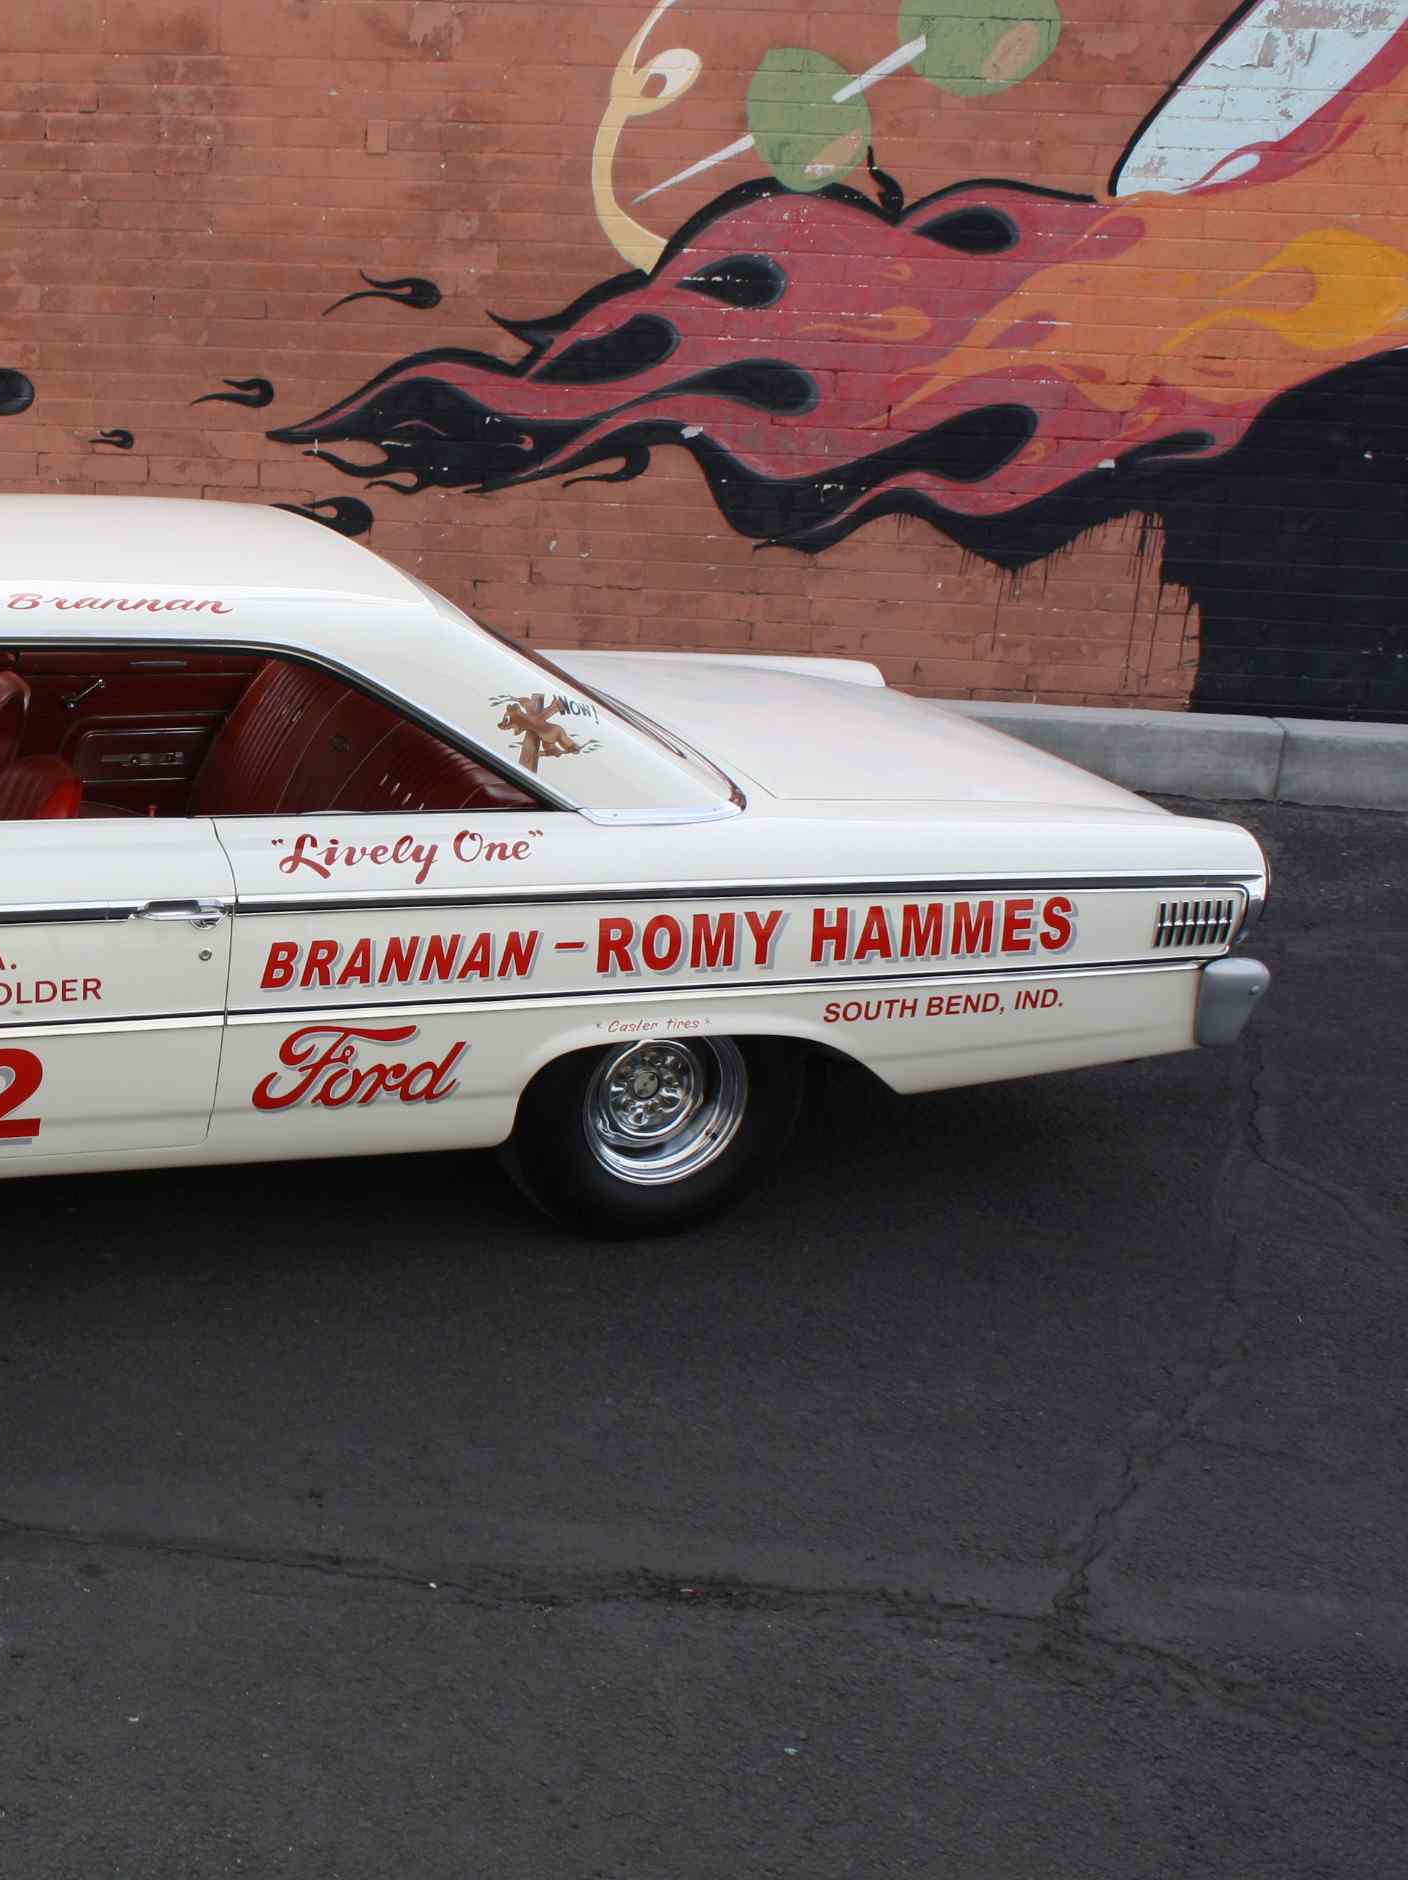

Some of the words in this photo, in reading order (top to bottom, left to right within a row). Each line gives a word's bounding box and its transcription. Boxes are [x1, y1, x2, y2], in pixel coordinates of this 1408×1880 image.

[7, 592, 233, 615] Brannan
[259, 929, 539, 990] BRANNAN
[596, 909, 785, 974] ROMY
[809, 895, 1074, 963] HAMMES
[823, 998, 919, 1023] SOUTH
[925, 992, 1005, 1016] BEND,
[1013, 988, 1064, 1010] IND.
[251, 1024, 469, 1111] Ford
